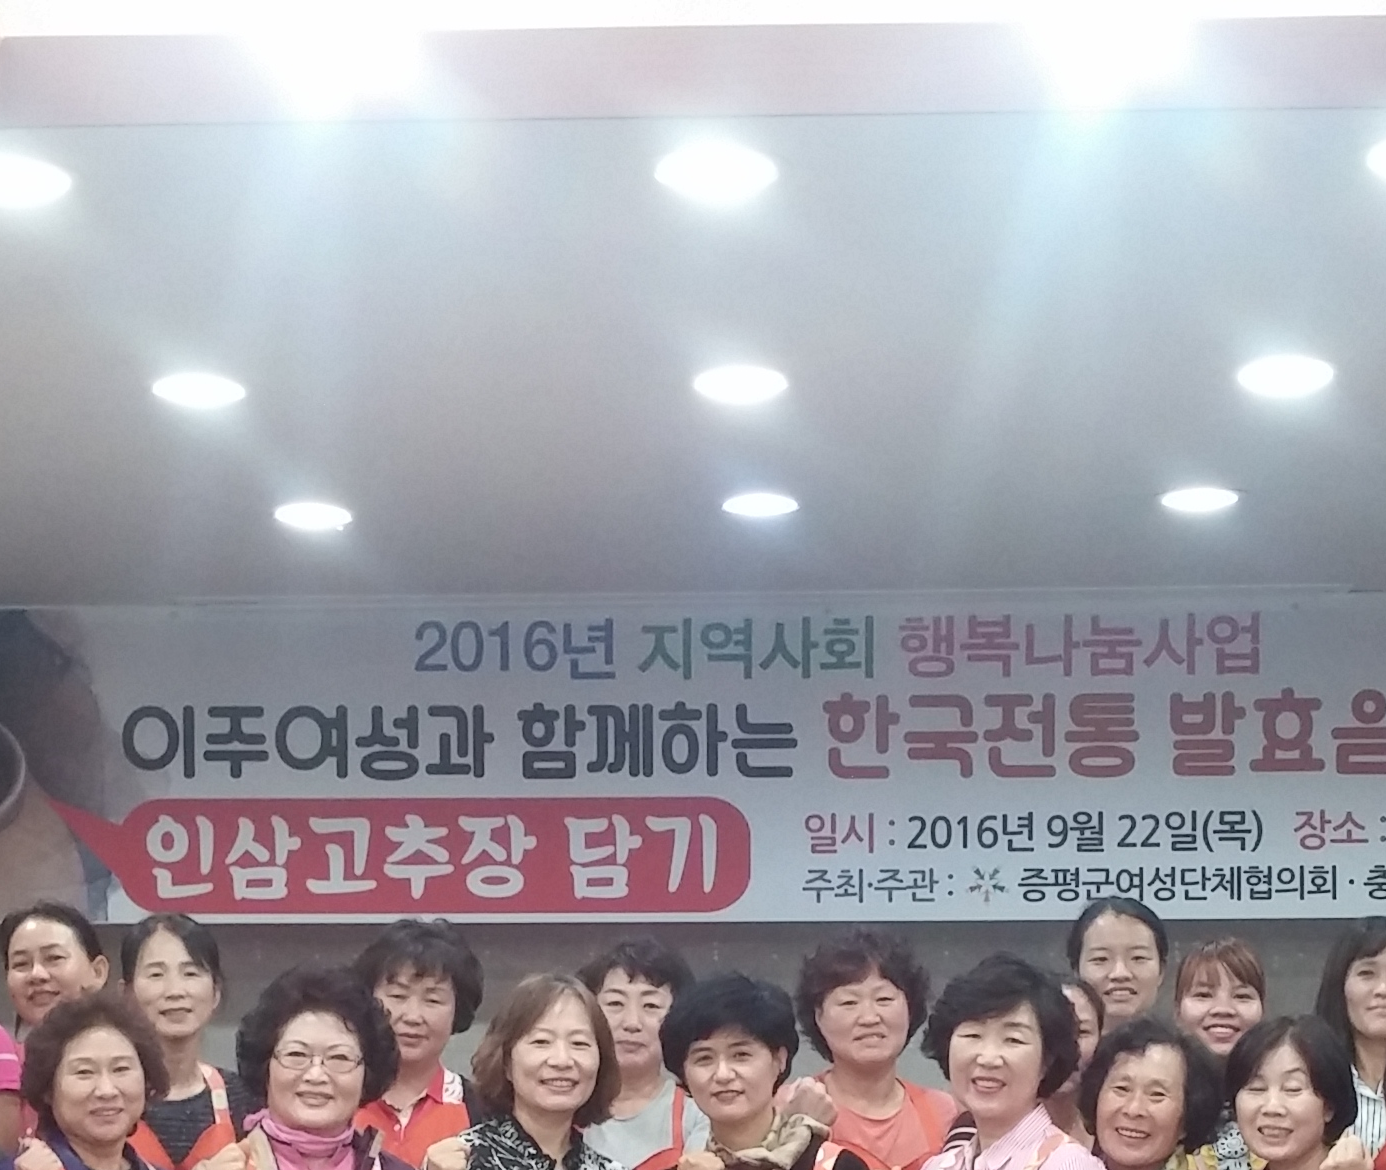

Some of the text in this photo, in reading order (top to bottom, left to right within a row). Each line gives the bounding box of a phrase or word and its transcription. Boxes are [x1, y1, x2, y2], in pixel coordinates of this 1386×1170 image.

[414, 611, 1261, 681] 2016년 지역사회 행복나눔사업
[121, 703, 495, 781] 이주여성과
[516, 700, 798, 780] 함께하는
[822, 690, 1141, 780] 한국전통
[145, 813, 717, 901] 인삼고추장 담기
[907, 810, 1035, 853] 2016년
[1046, 810, 1105, 853] 9월
[1116, 808, 1264, 853] 22일(목)
[1017, 864, 1338, 903] 증평군여성단체협의회
